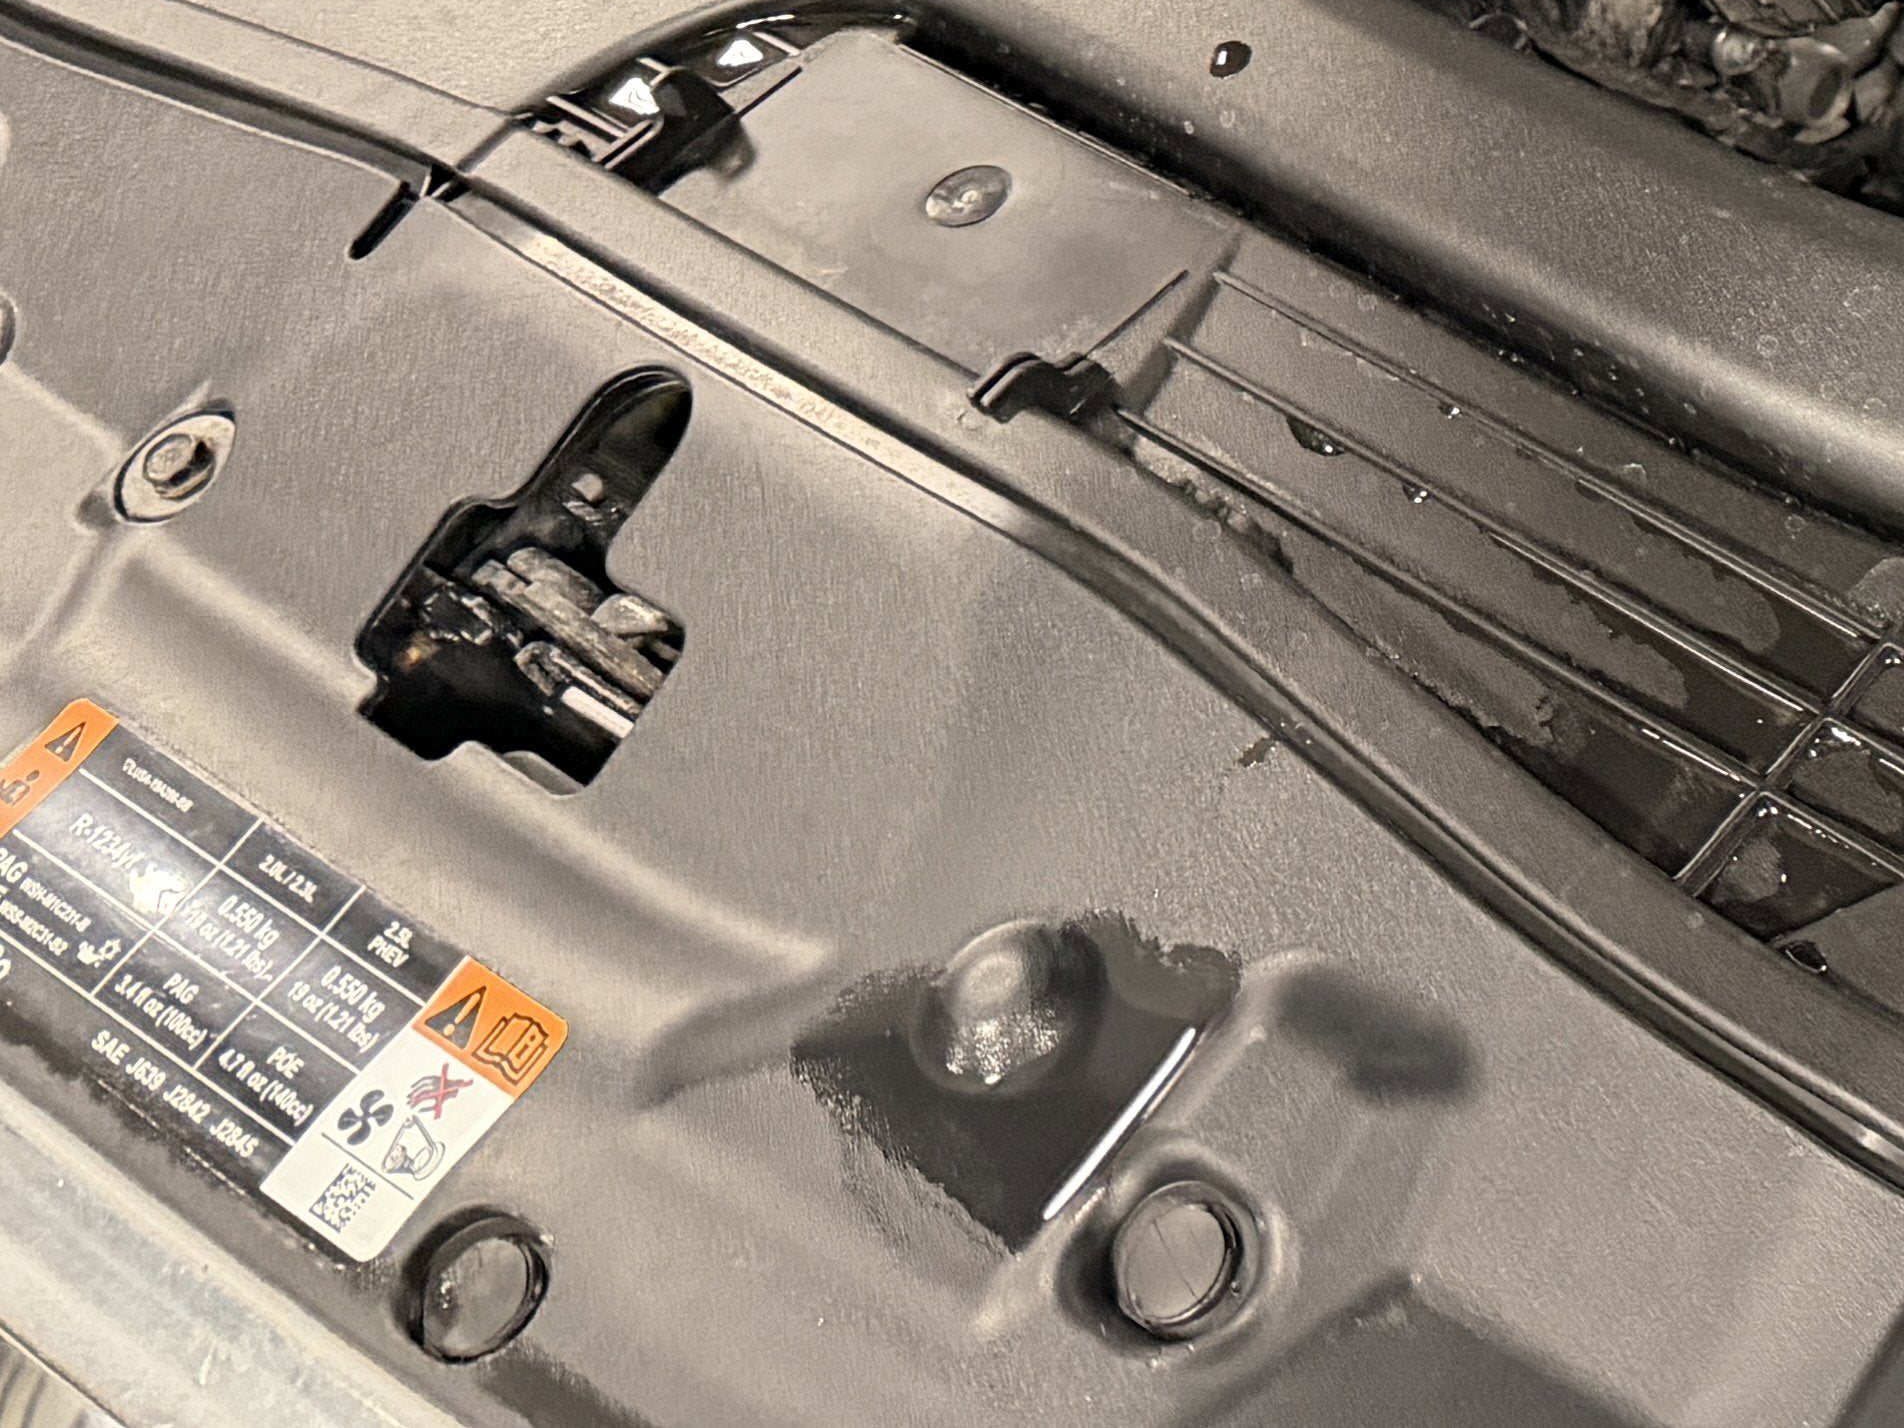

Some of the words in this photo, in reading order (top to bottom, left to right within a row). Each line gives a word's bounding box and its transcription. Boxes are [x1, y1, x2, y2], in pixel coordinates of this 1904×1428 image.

[68, 813, 146, 880] R-1234yf
[258, 854, 288, 882] 2.0L
[199, 923, 220, 942] oz
[210, 930, 255, 965] (1.21
[217, 895, 264, 934] 0.550
[253, 919, 280, 951] kg
[367, 935, 409, 968] PHEV
[114, 974, 143, 1000] 3.4
[143, 998, 164, 1018] oz
[155, 1005, 208, 1051] (100cc)
[163, 972, 200, 1004] PAG
[320, 966, 367, 1006] 0.550
[358, 991, 386, 1024] kg
[287, 981, 310, 1002] 19
[303, 994, 324, 1014] oz
[314, 1002, 356, 1037] (1.21
[348, 1022, 380, 1054] lbs)
[218, 1048, 246, 1072] 4.7
[247, 1072, 268, 1092] oz
[259, 1080, 314, 1126] (140cc)
[266, 1046, 305, 1079] POE
[90, 1029, 129, 1066] SAE
[126, 1056, 167, 1103] J639
[163, 1085, 210, 1132] J2842
[209, 1116, 259, 1159] J2845
